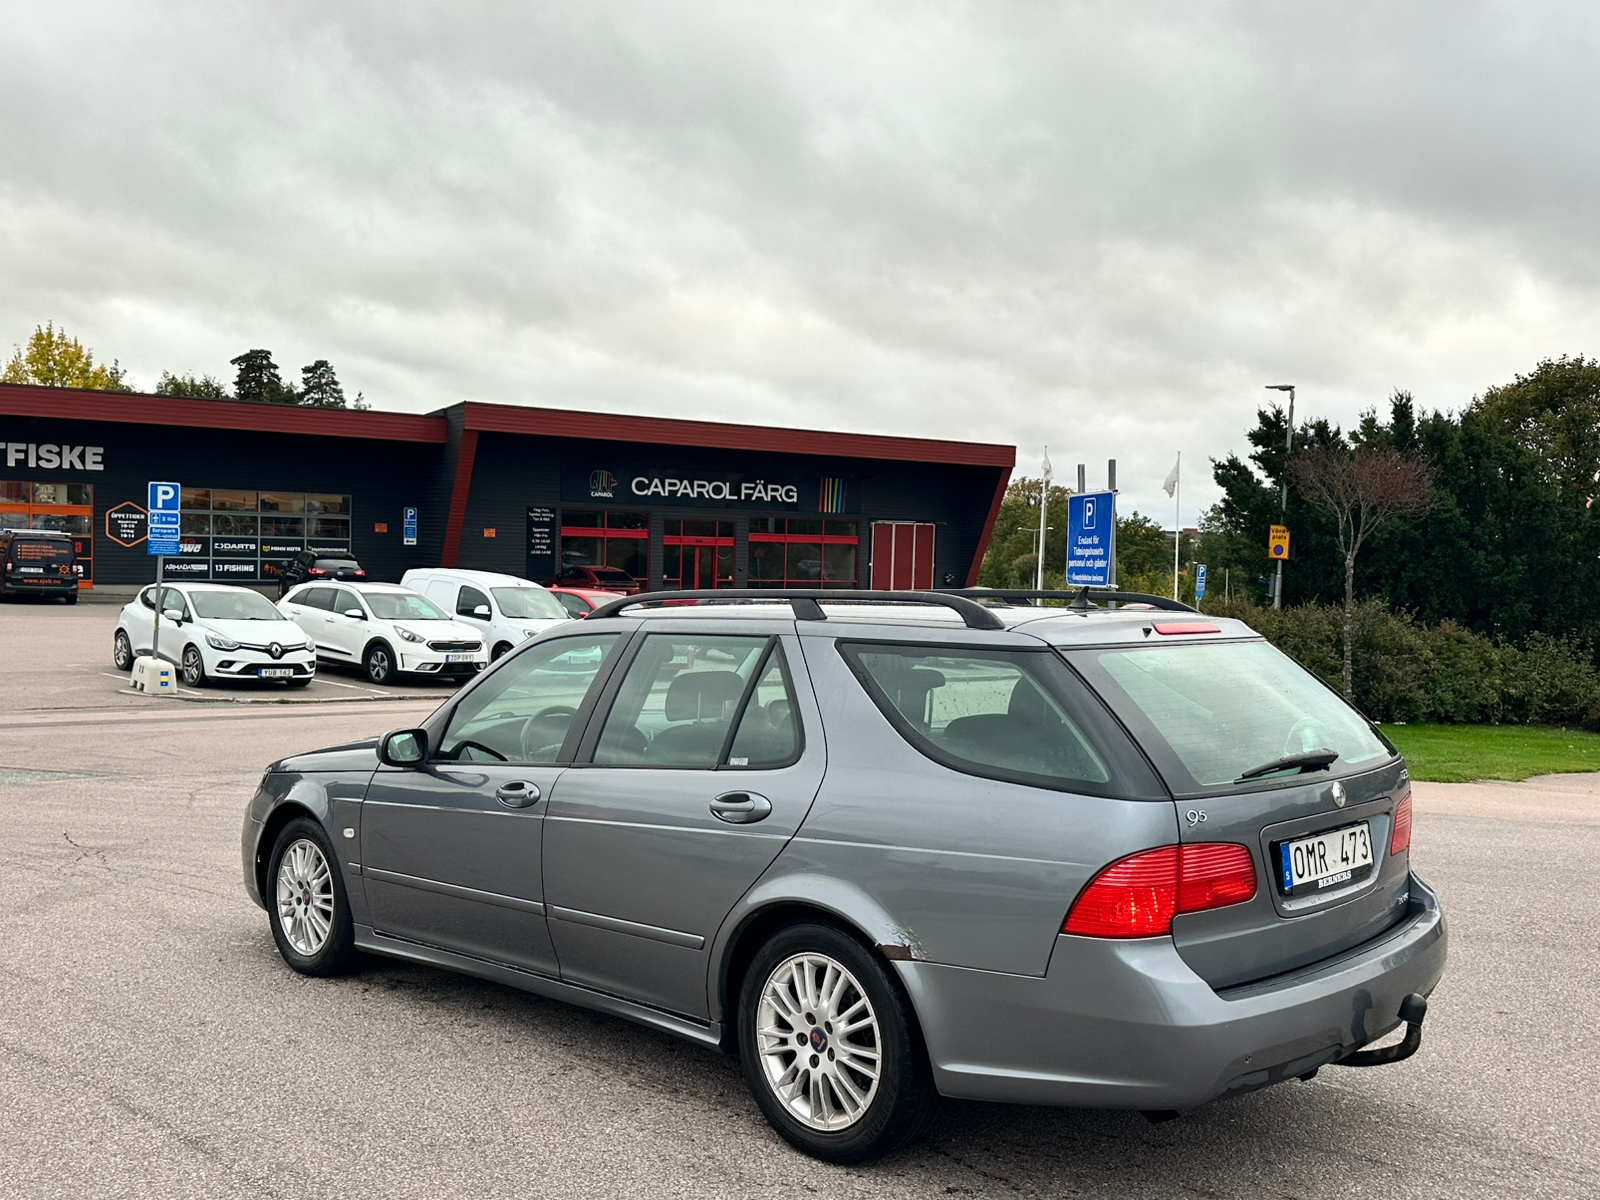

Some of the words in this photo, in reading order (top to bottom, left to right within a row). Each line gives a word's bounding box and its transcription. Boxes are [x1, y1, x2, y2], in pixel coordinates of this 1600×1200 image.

[632, 477, 737, 500] CAPAROL
[741, 480, 797, 502] FÄRG
[157, 485, 174, 508] P
[407, 509, 415, 519] P
[1086, 502, 1093, 524] P
[1078, 536, 1093, 545] Endast
[1073, 546, 1104, 558] Tidningshusets
[1069, 559, 1085, 568] personal
[1094, 558, 1107, 569] gäster
[1199, 566, 1204, 576] P
[1294, 841, 1329, 879] OMR
[1340, 830, 1369, 864] 473
[1286, 871, 1290, 881] S
[1318, 870, 1352, 888] BERNERS
